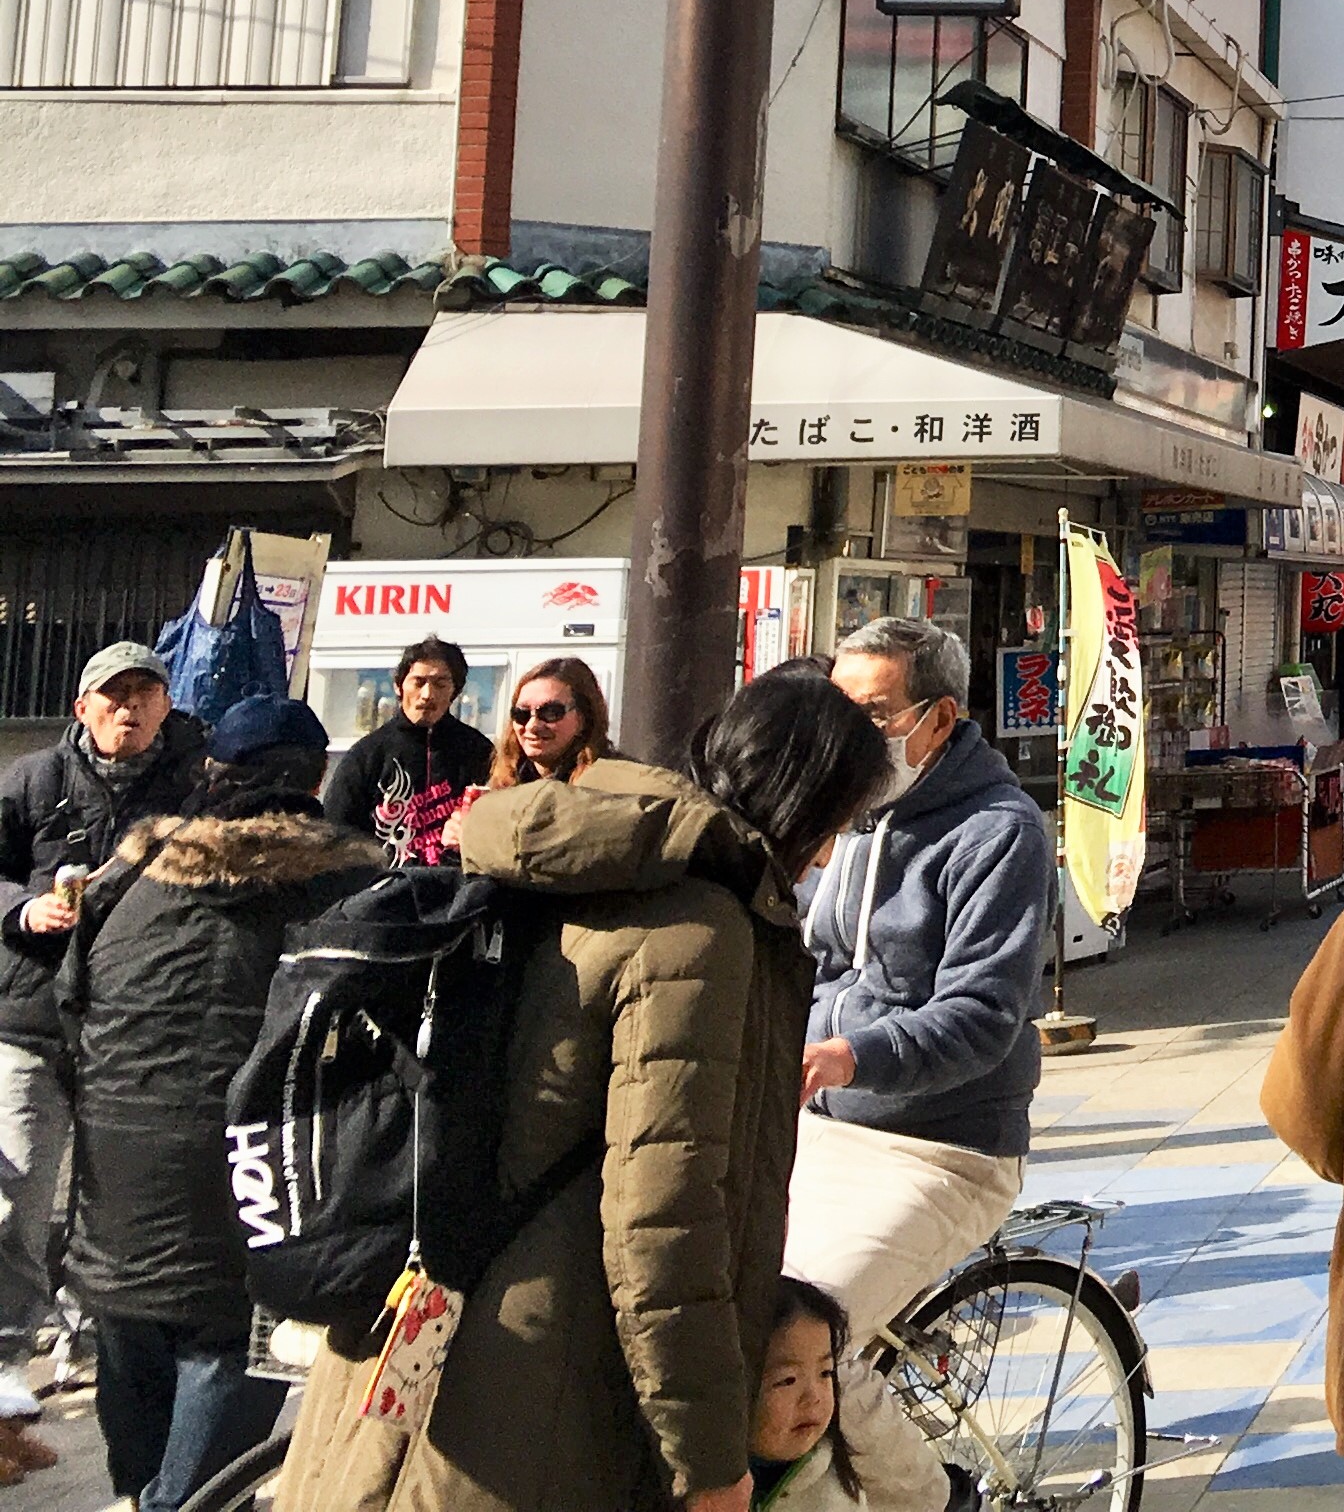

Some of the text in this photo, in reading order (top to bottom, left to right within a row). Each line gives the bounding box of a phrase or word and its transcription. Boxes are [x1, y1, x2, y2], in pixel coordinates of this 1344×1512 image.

[749, 413, 1042, 446] たばこ・和洋酒
[333, 582, 453, 616] KIRIN
[1016, 654, 1052, 724] ラムネ
